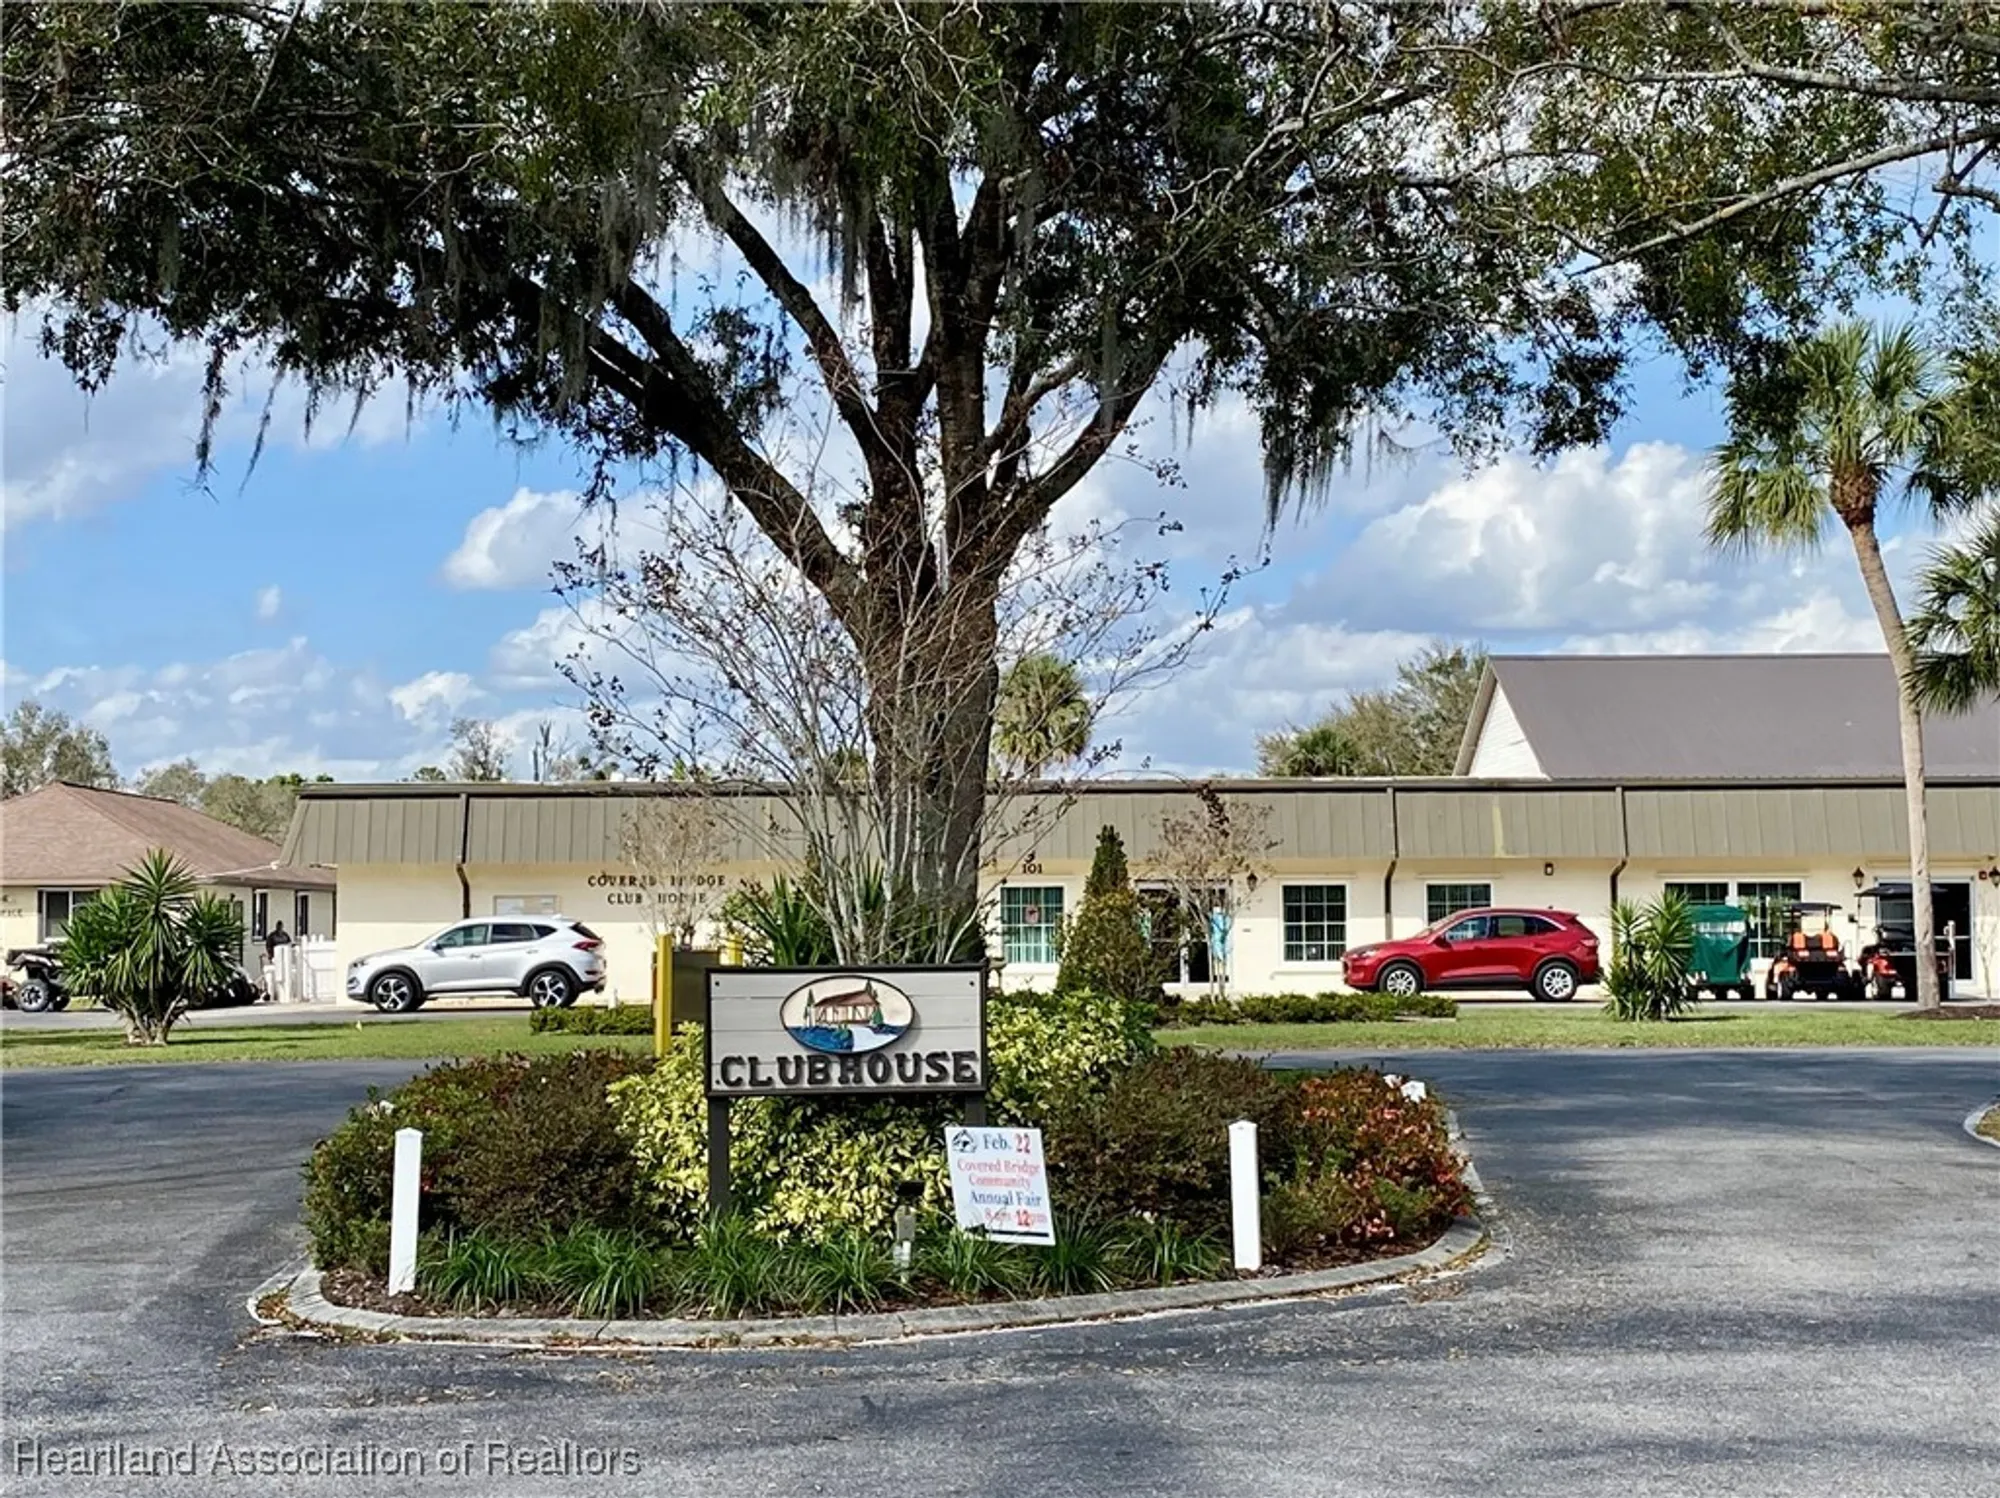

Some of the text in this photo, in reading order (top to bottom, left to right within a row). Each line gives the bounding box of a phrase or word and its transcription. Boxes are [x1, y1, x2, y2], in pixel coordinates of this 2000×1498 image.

[1022, 863, 1043, 875] 101
[607, 892, 643, 905] CLUB
[720, 1051, 979, 1087] CLUBHOUSE
[983, 1132, 1031, 1154] Feb. 22
[957, 1158, 1039, 1176] Covered Bridge
[968, 1174, 1031, 1190] Community
[970, 1190, 1042, 1207] Annual Fair
